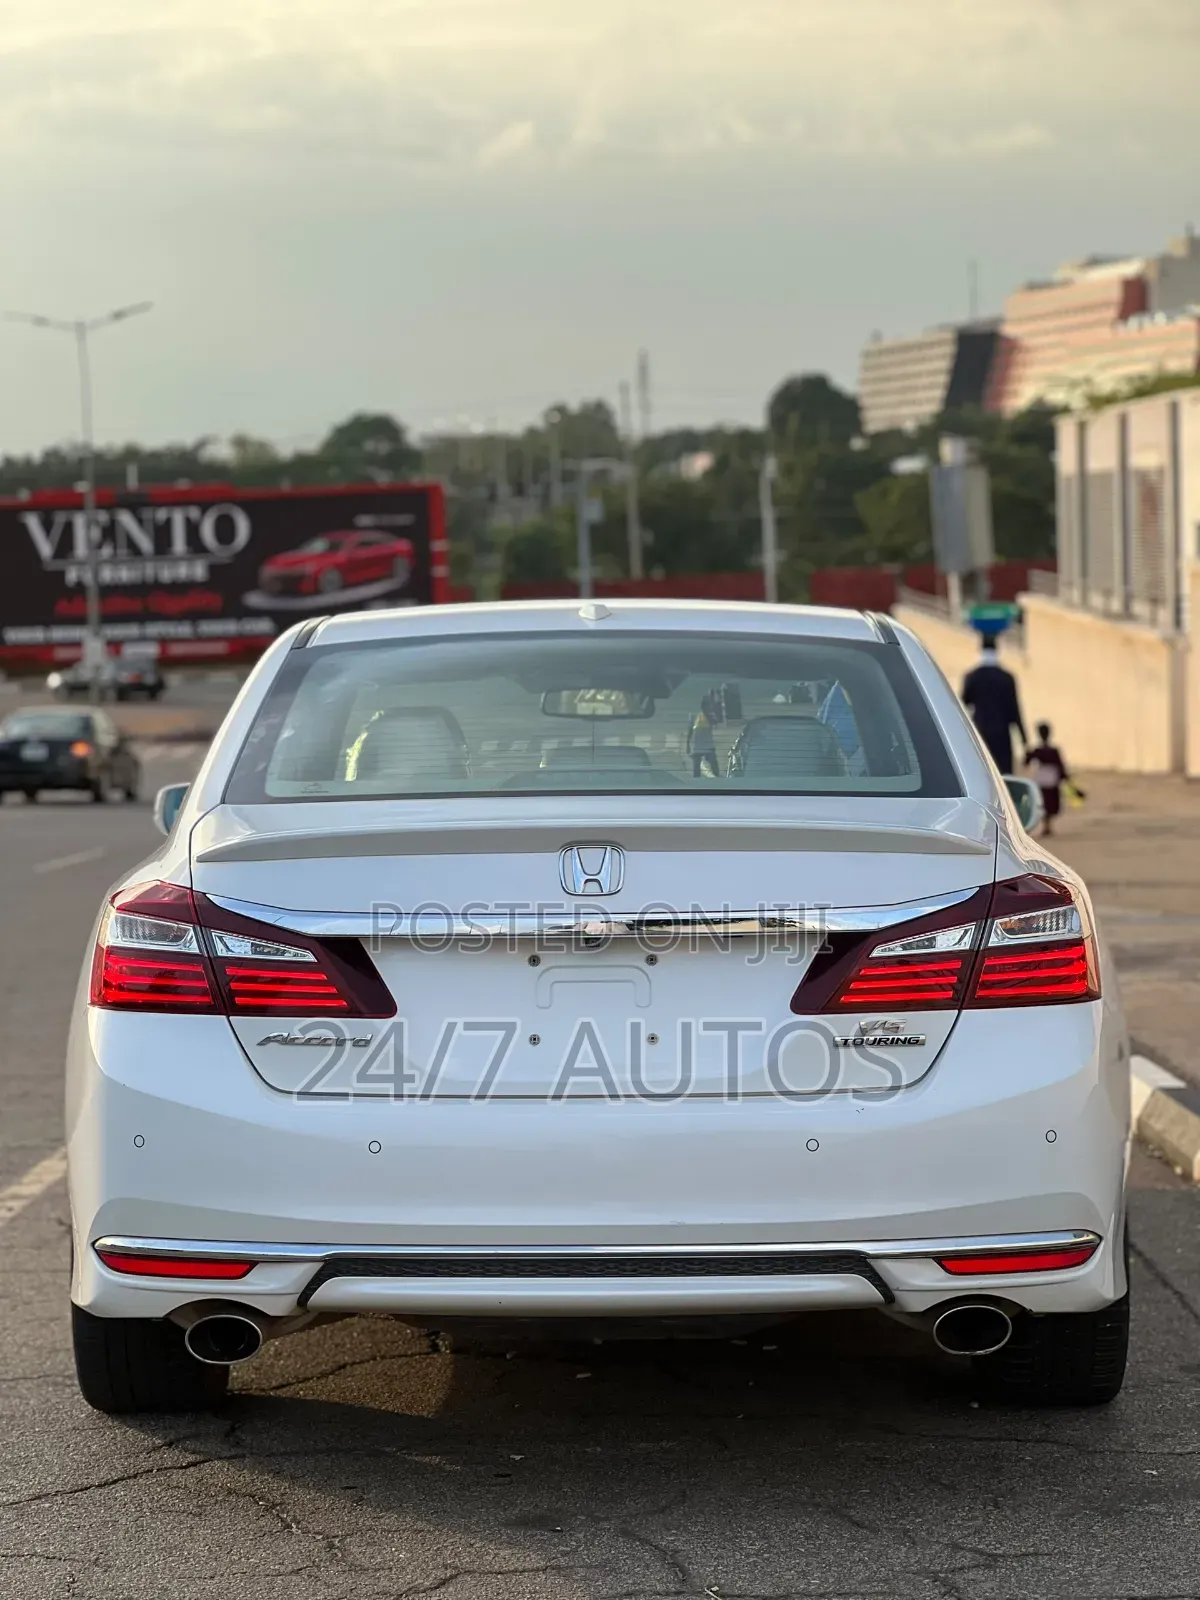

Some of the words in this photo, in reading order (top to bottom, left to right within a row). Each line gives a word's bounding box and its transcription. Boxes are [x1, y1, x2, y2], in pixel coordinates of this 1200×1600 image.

[18, 502, 252, 559] VENTO
[256, 1033, 373, 1047] Accord
[840, 1036, 921, 1047] TOURING
